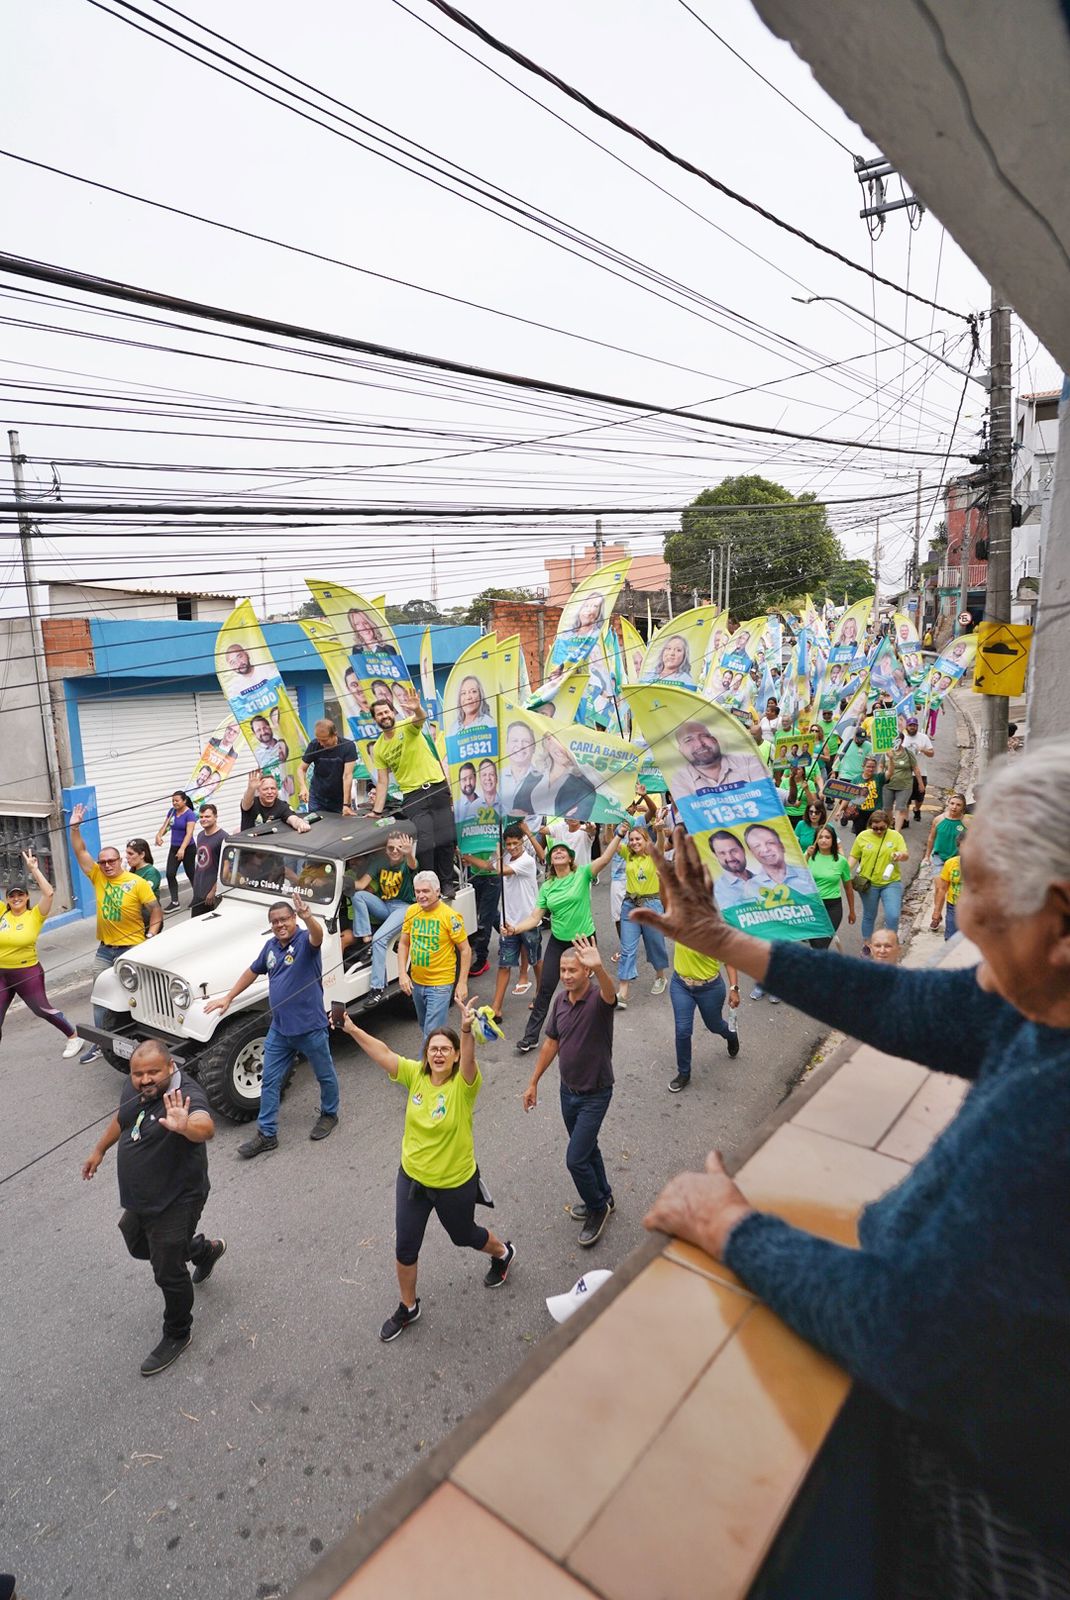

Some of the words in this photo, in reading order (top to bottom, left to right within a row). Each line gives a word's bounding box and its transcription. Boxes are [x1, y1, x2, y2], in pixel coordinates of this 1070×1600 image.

[876, 717, 897, 729] PARI
[876, 728, 898, 739] MOS
[459, 740, 492, 759] 55321
[570, 740, 600, 755] CARLA
[477, 806, 496, 825] 22
[703, 800, 760, 824] 11333
[260, 880, 279, 891] Clube
[758, 884, 795, 910] 22
[737, 904, 814, 928] PARIMOSCHI
[412, 918, 440, 936] PARI
